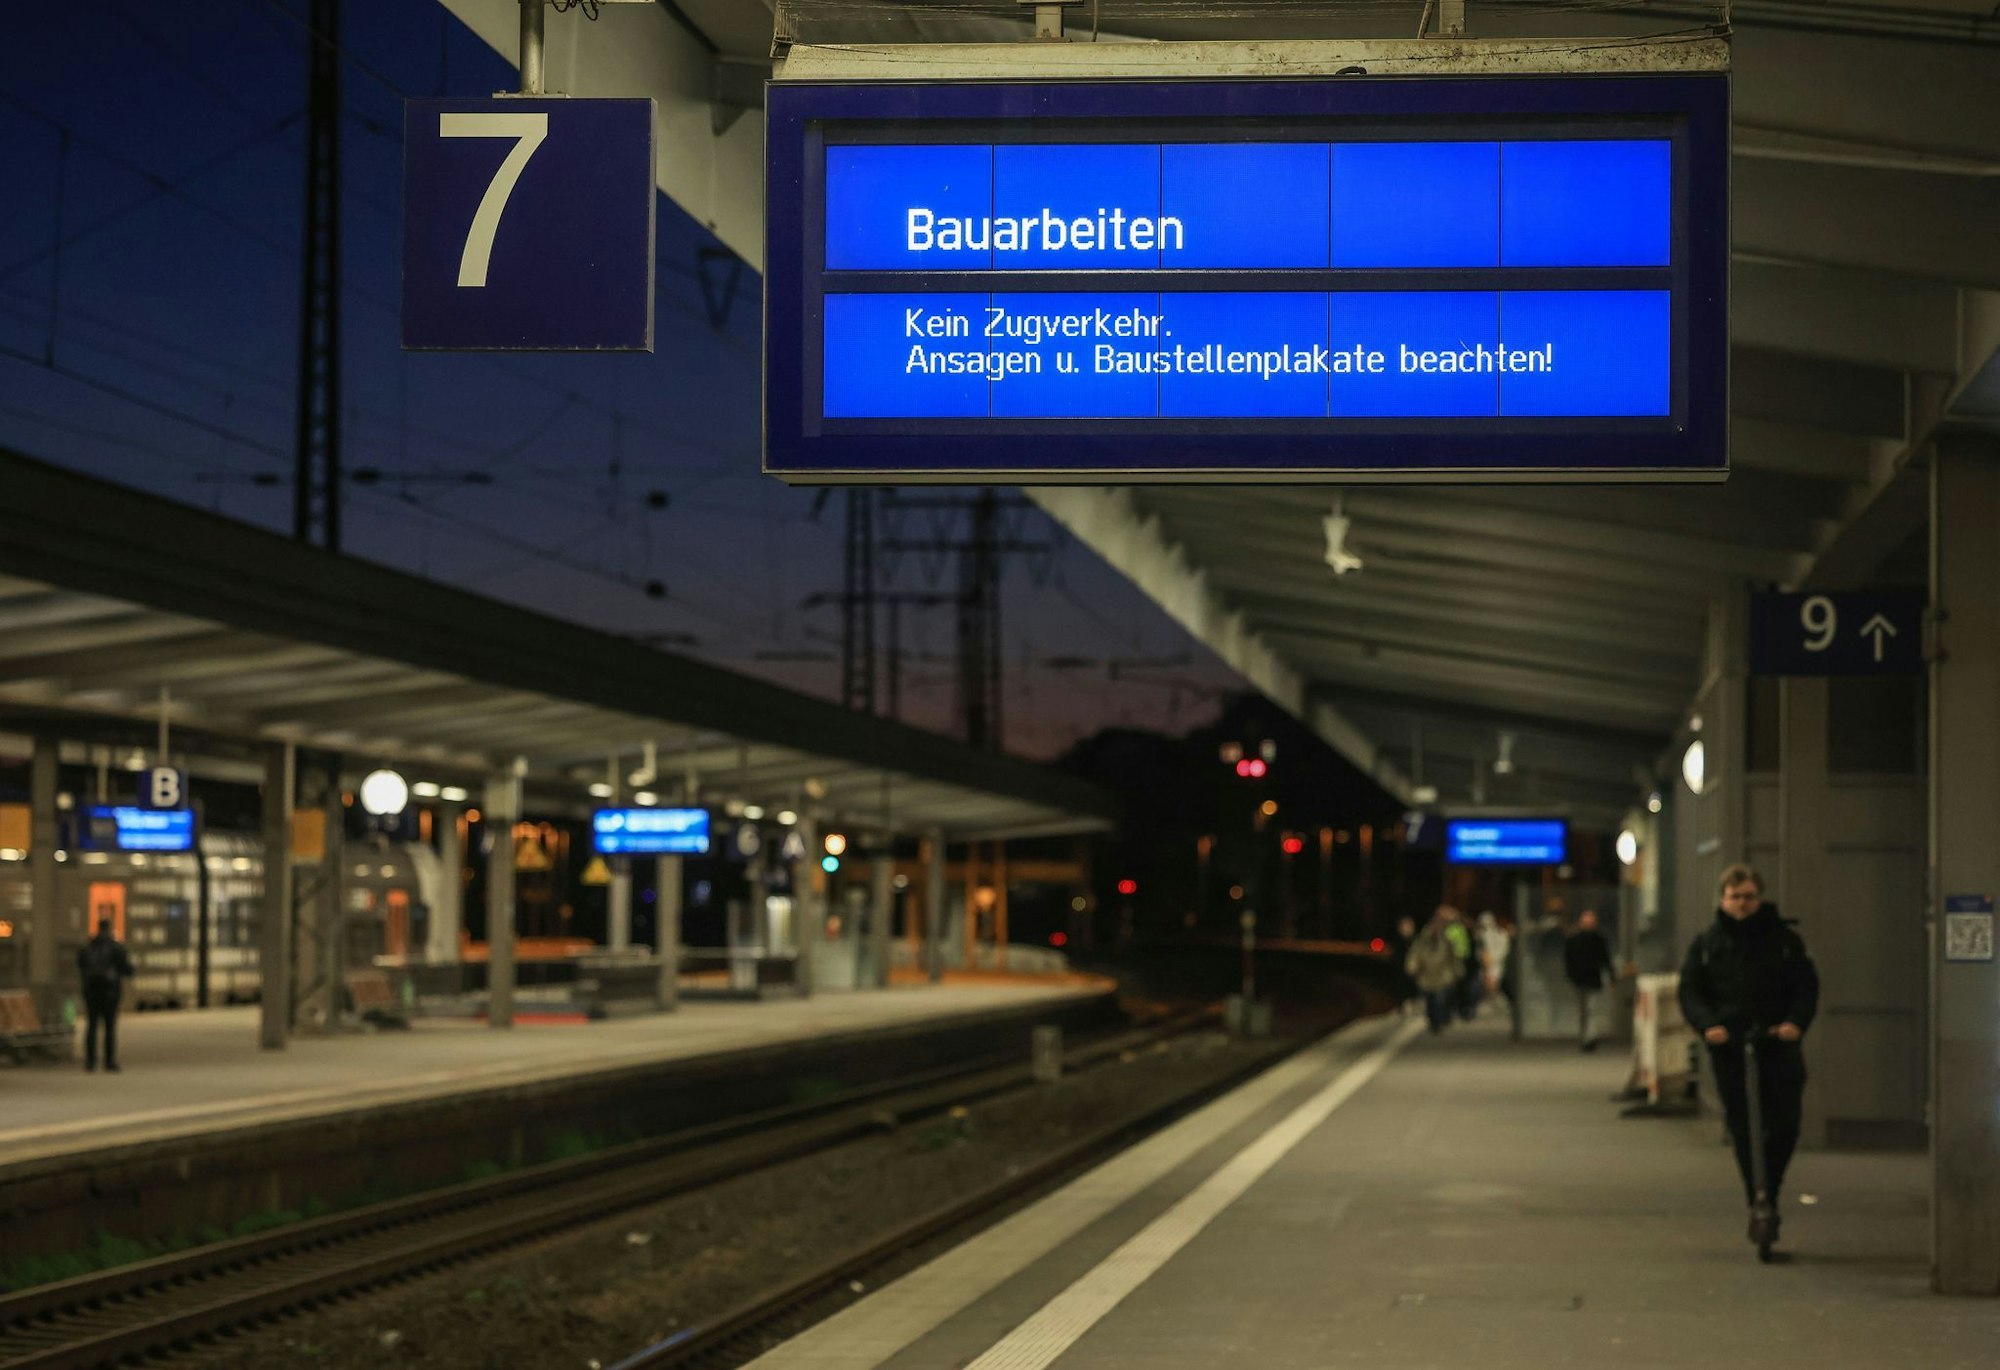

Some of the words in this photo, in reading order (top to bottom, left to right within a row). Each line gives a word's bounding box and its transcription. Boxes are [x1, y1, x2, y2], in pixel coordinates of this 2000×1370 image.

[439, 112, 549, 287] 7
[905, 207, 1184, 251] Bauarbeiten
[905, 308, 969, 337] Kein
[985, 308, 1172, 346] Zugverkehr.
[905, 346, 1041, 381] Ansagen
[1056, 353, 1079, 373] u.
[1094, 343, 1385, 381] Baustellenplakate
[1400, 343, 1553, 373] beachten!
[1801, 596, 1836, 651] 9
[152, 768, 180, 807] B
